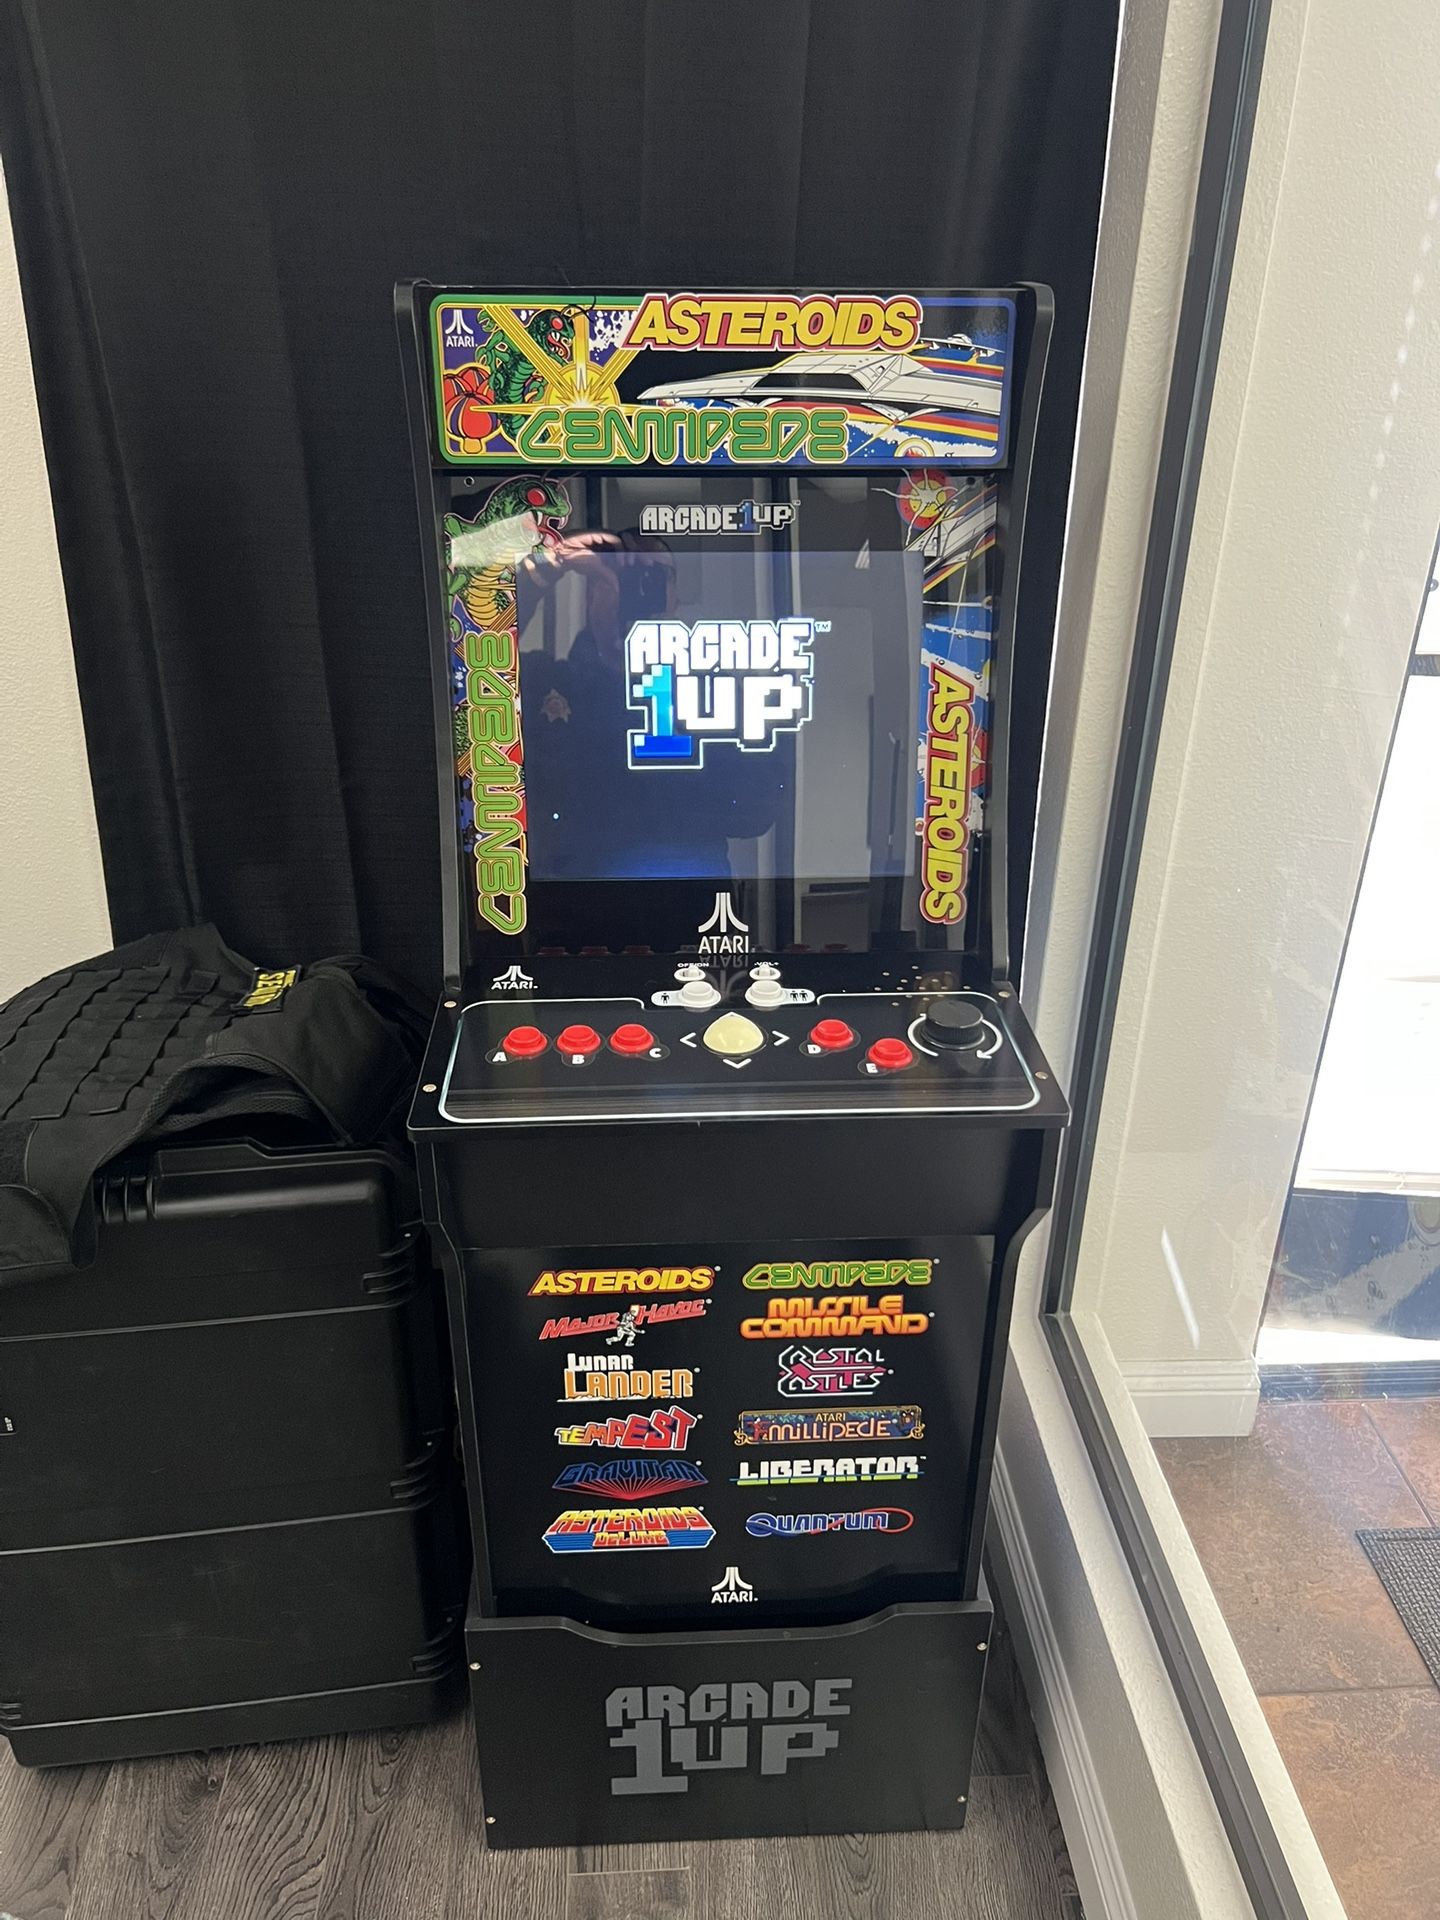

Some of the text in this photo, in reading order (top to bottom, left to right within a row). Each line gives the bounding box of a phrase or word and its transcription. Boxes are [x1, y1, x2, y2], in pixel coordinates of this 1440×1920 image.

[622, 294, 922, 351] ASTEROIDS
[446, 335, 475, 348] ATARI
[518, 407, 850, 463] CENTIPEDE
[628, 621, 811, 676] ARCADE
[632, 664, 802, 759] 1UP
[465, 631, 527, 934] CENTIPEDE
[920, 661, 975, 925] ASTEROIDS
[698, 935, 749, 954] ATARI
[491, 981, 534, 990] ATARI
[492, 1051, 507, 1062] A
[572, 1054, 585, 1065] B
[649, 1048, 663, 1058] C
[807, 1044, 822, 1054] D
[865, 1063, 879, 1074] E
[528, 1266, 715, 1296] ASTEROIDS
[742, 1258, 932, 1290] CENTIPEDE
[767, 1295, 904, 1318] MISSILE
[740, 1313, 929, 1339] COMMAND
[564, 1368, 694, 1400] LANDER
[554, 1405, 697, 1450] TEMPEST
[815, 1412, 846, 1422] ATARI
[552, 1460, 709, 1488] GRAVITAR
[738, 1456, 919, 1482] LIBERATOR
[545, 1507, 713, 1535] ASTEROIDS
[745, 1512, 889, 1537] QUANTUM
[711, 1590, 753, 1603] ATARI
[605, 1678, 852, 1727] ARCADE
[609, 1719, 840, 1795] 1UP
